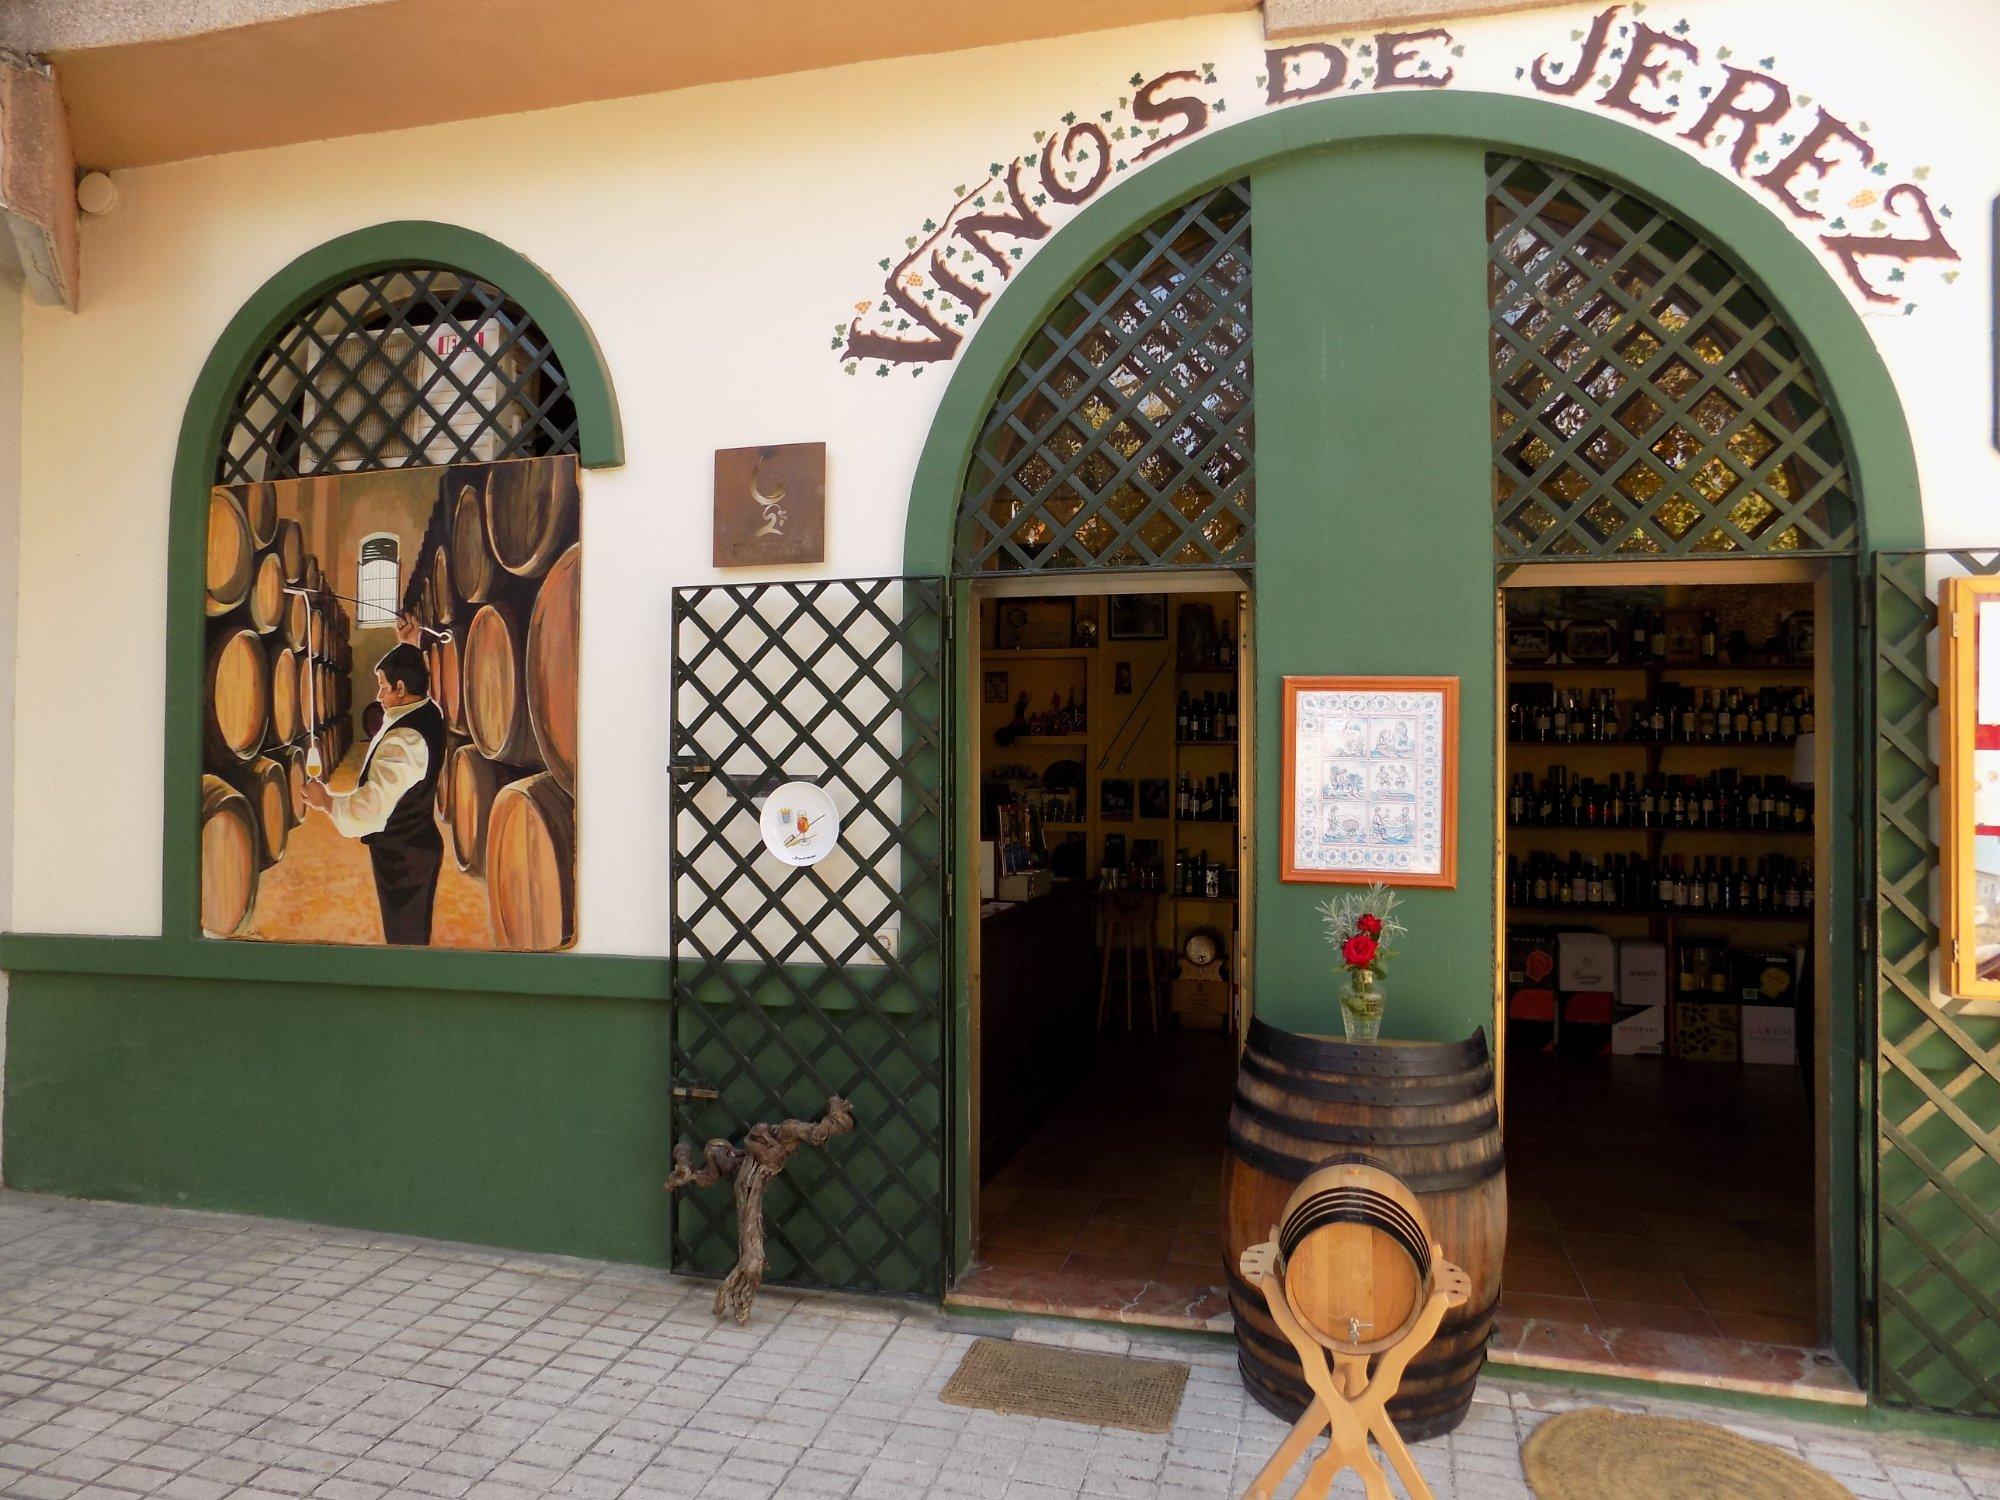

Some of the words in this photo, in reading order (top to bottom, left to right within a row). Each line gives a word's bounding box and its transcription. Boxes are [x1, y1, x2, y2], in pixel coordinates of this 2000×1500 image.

[840, 70, 1210, 363] VINOS
[1264, 28, 1455, 106] DE
[1530, 5, 1962, 304] JEREZ
